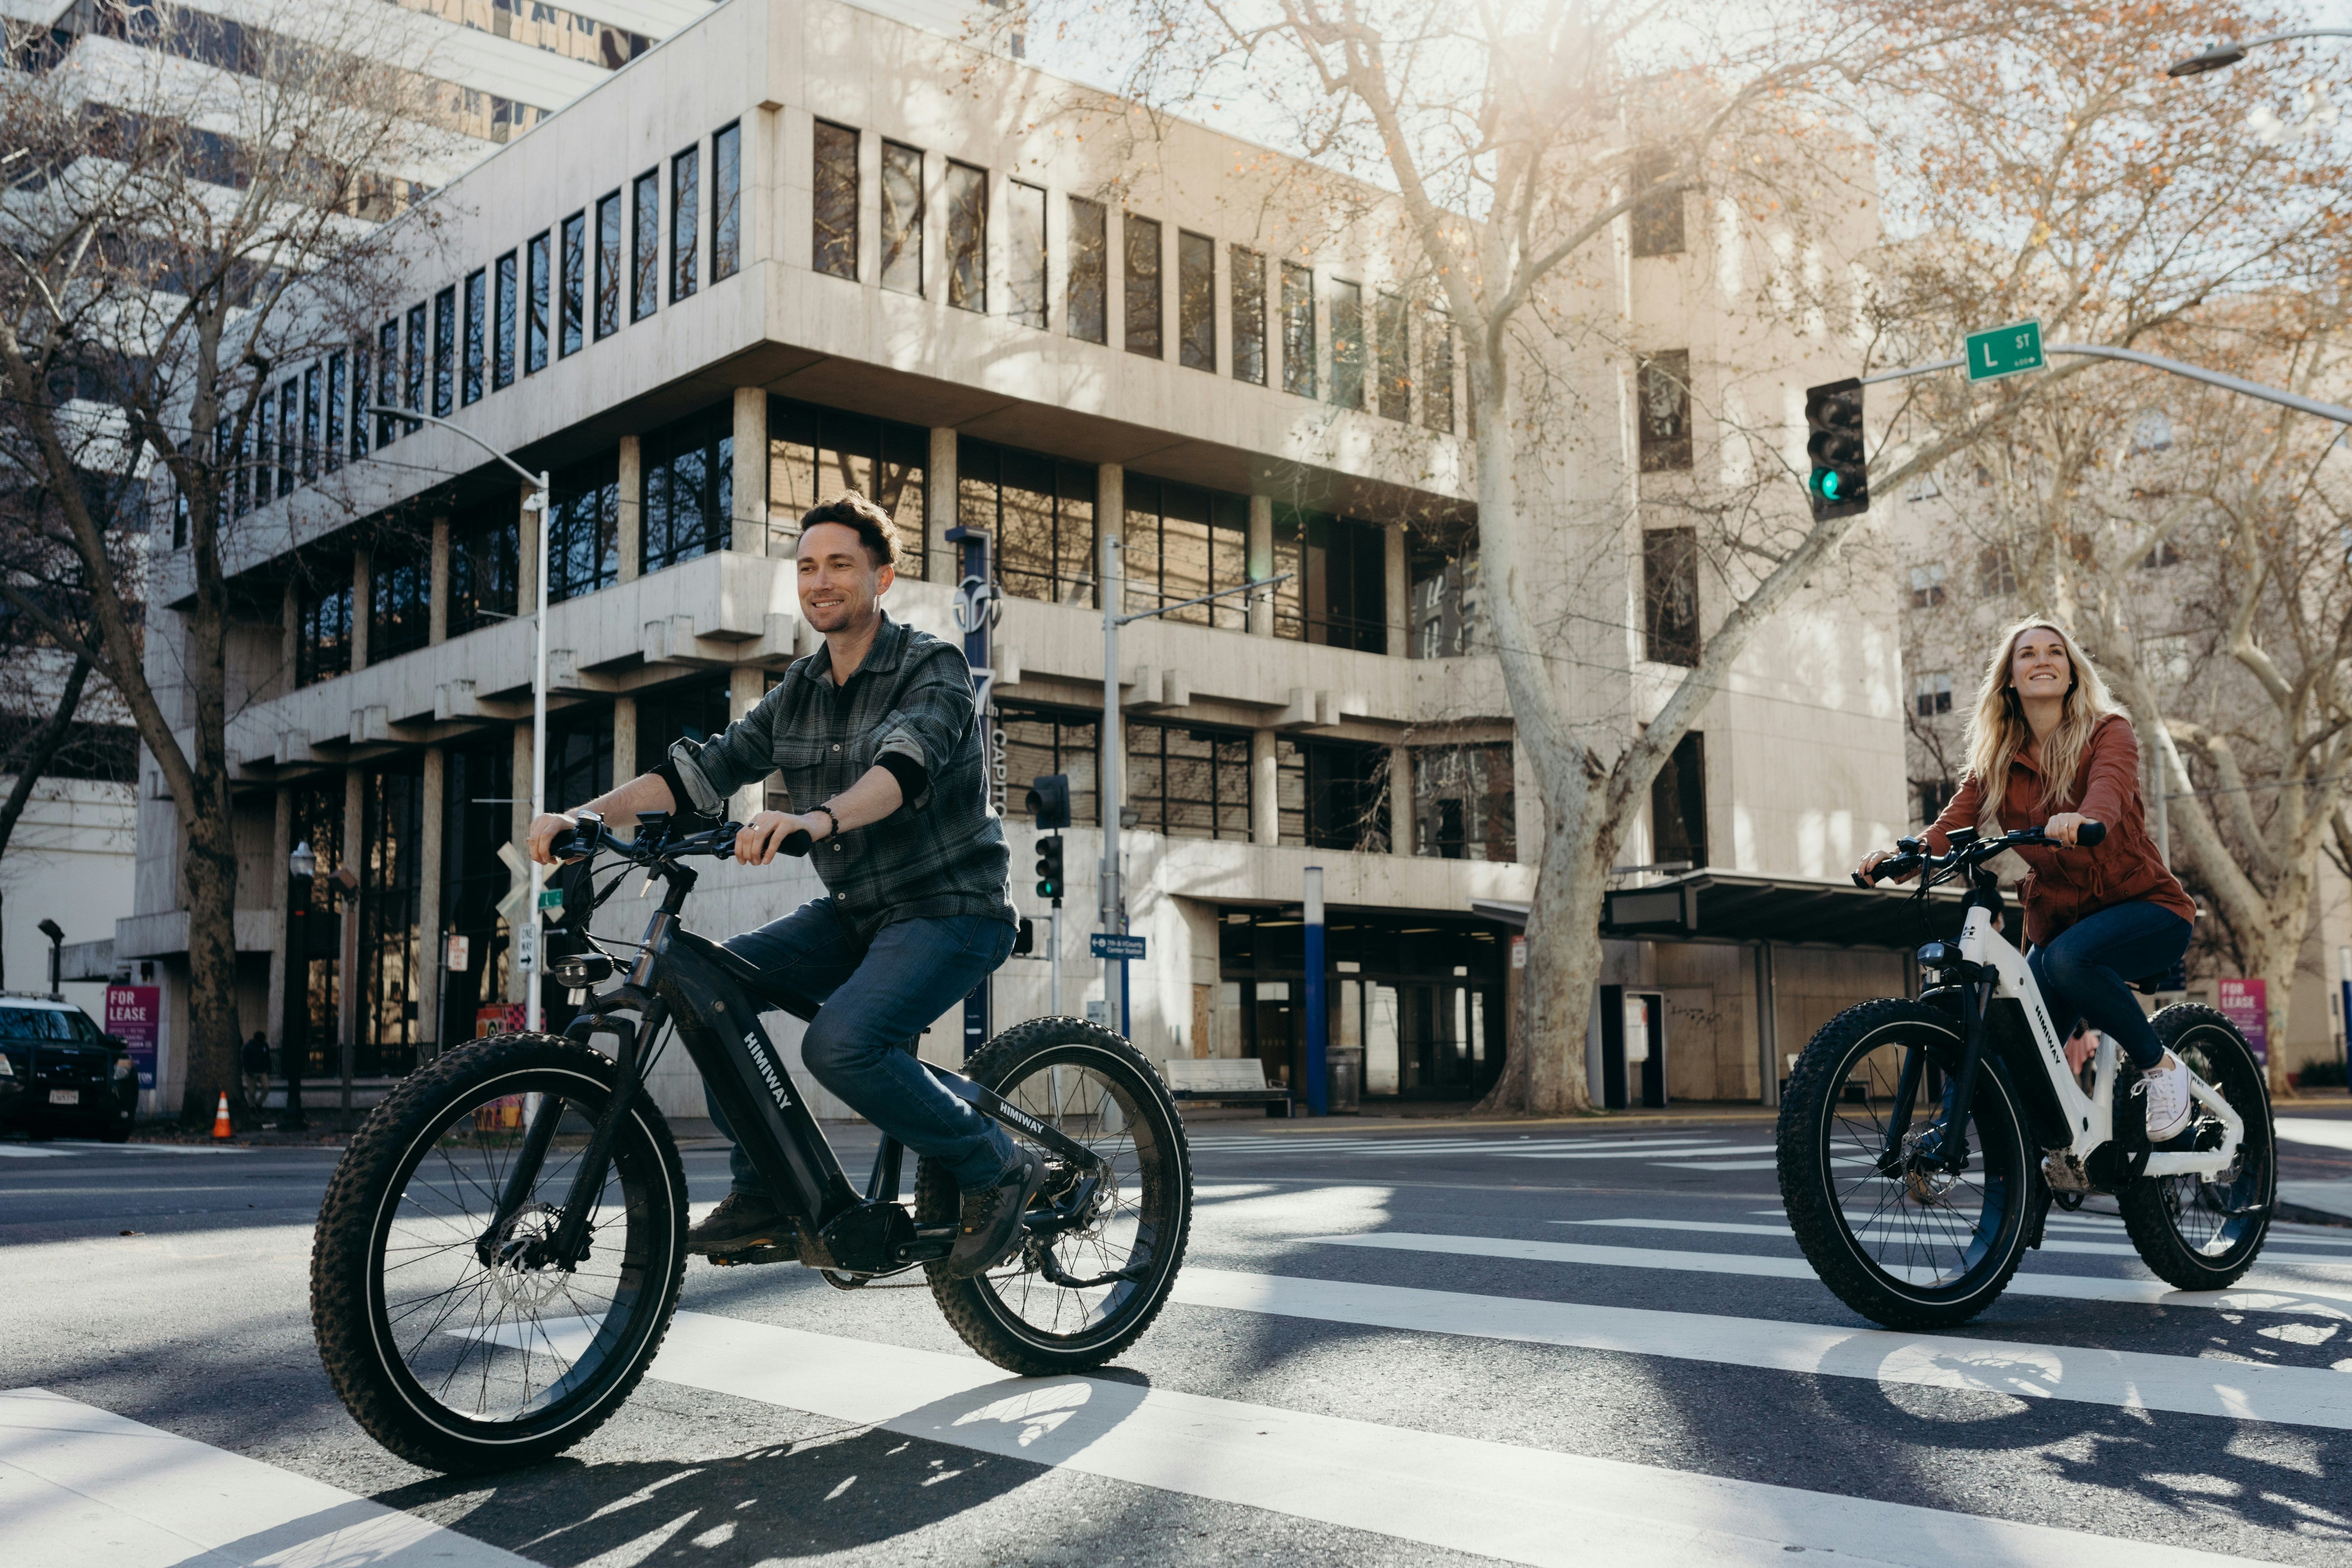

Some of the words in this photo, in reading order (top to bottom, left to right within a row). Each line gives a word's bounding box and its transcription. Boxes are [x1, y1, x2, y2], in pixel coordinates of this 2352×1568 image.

[1983, 343, 1998, 368] L
[2015, 333, 2030, 350] ST
[522, 927, 533, 939] ONE
[521, 941, 532, 952] WAY
[2221, 982, 2244, 995] FOR
[110, 991, 135, 1005] FOR
[2221, 996, 2256, 1009] LEASE
[109, 1007, 147, 1021] LEASE
[2035, 1005, 2060, 1065] HIMIWAY
[744, 1031, 792, 1109] HIMIWAY
[1000, 1102, 1045, 1134] HIMIWAY
